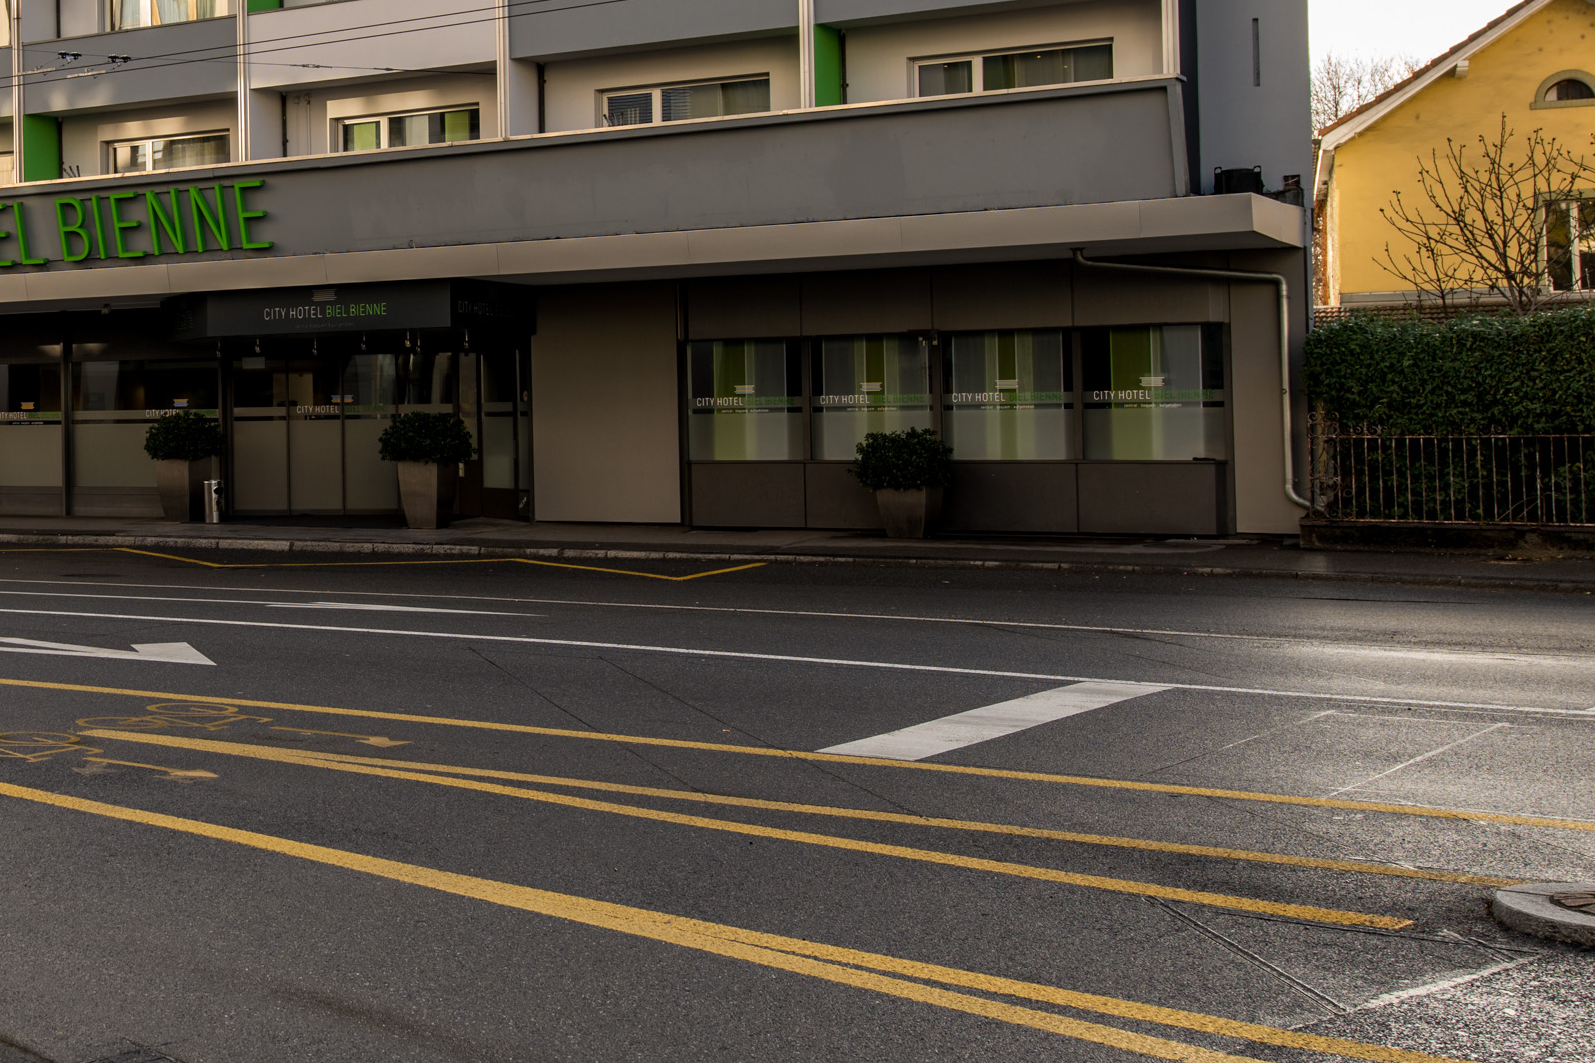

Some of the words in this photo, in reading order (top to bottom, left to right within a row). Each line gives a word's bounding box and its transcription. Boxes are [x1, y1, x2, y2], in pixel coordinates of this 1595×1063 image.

[56, 179, 274, 262] BIENNE
[263, 307, 287, 320] CITY
[289, 306, 323, 319] HOTEL
[326, 304, 347, 318] BIEL
[350, 302, 387, 316] BIENNE
[819, 395, 839, 405] CITY
[841, 394, 871, 404] HOTEL
[952, 392, 973, 403] CITY
[975, 392, 1006, 402] HOTEL
[1093, 390, 1116, 401] CITY
[1118, 389, 1150, 400] HOTEL
[696, 397, 715, 407] CITY
[716, 397, 744, 406] HOTEL
[145, 409, 160, 418] CITY
[296, 405, 314, 414] CITY
[315, 404, 340, 414] HOTEL
[8, 411, 27, 420] HOTEL
